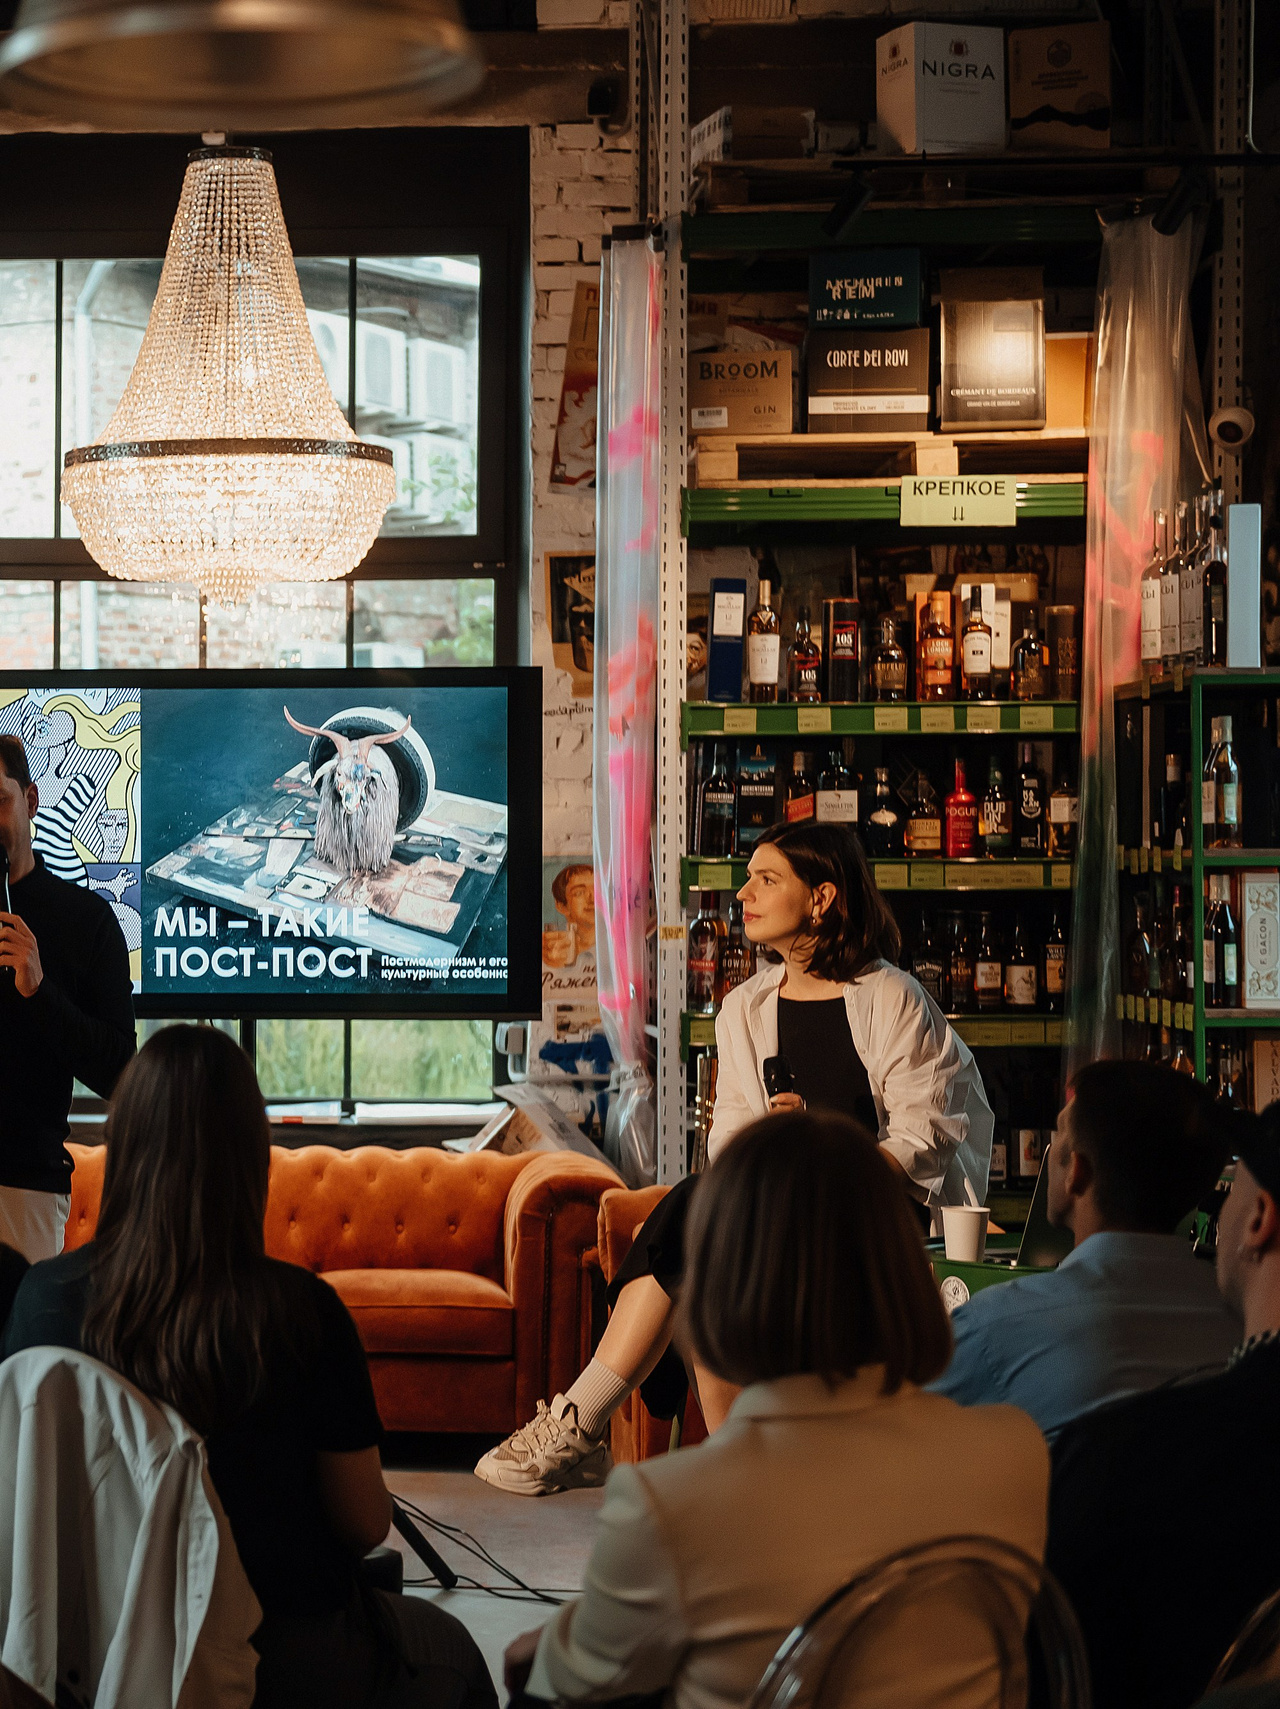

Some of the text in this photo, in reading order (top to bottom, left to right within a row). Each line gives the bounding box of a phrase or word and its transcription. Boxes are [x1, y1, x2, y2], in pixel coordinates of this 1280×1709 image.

[922, 60, 995, 80] NIGRA
[827, 350, 909, 368] CORTE DEI ROVI
[700, 361, 778, 380] BROOM
[754, 405, 776, 414] GIN
[913, 481, 1006, 496] КРЕПКОЕ
[835, 634, 853, 645] 105
[801, 670, 817, 681] 105
[153, 906, 217, 937] МЫ
[257, 906, 370, 937] ТАКИЕ
[154, 946, 373, 978] ПОСТ-ПОСТ
[381, 955, 508, 970] Постмодернизм и его
[381, 968, 449, 981] культурные
